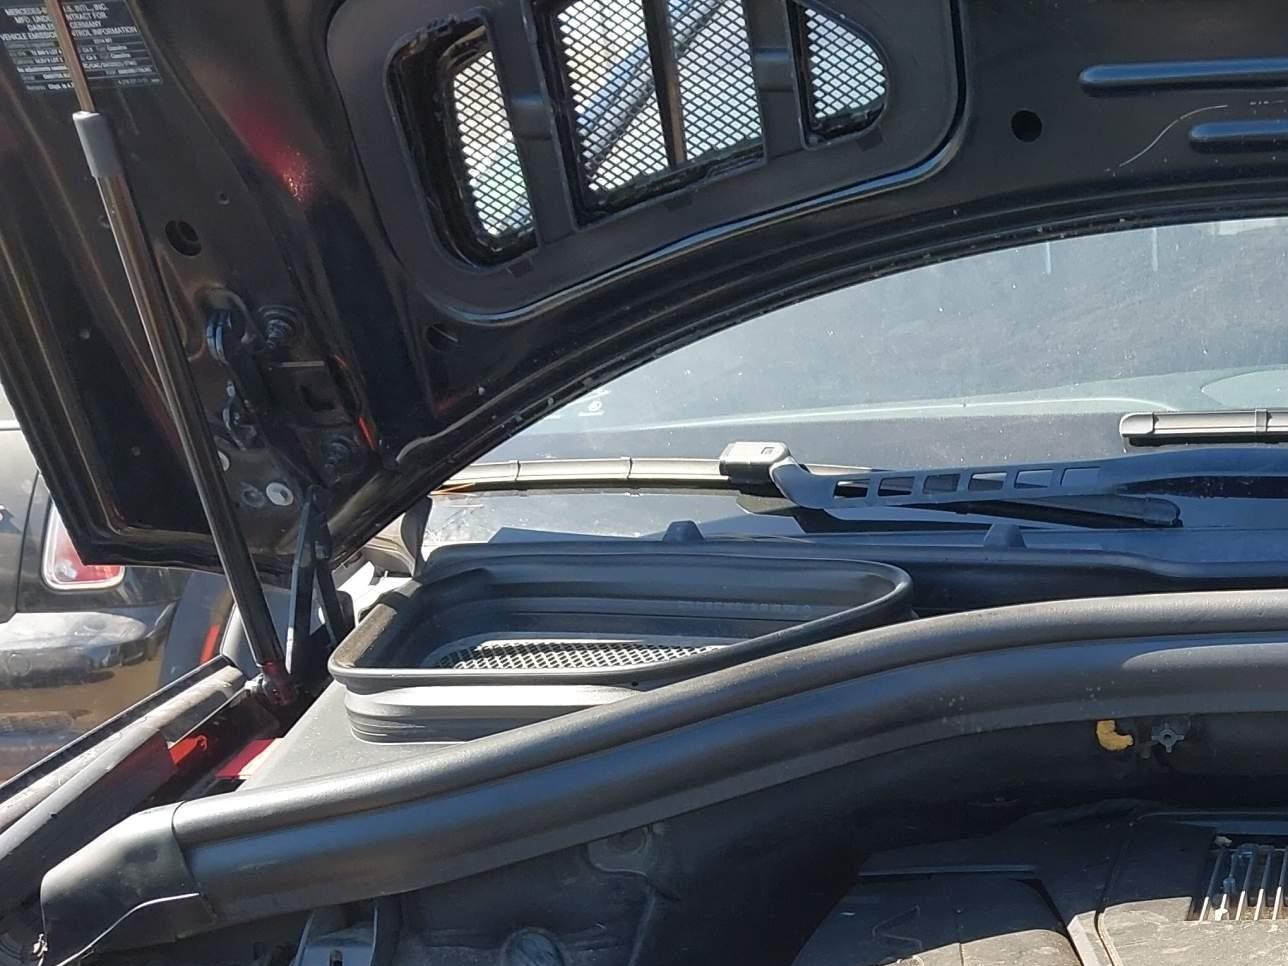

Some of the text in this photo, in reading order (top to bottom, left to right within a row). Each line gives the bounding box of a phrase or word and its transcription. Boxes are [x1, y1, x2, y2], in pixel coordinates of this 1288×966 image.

[32, 15, 53, 23] UNDE
[65, 12, 92, 21] NTRACT
[27, 23, 55, 31] DAIMLE
[92, 26, 138, 36] INFORMATION
